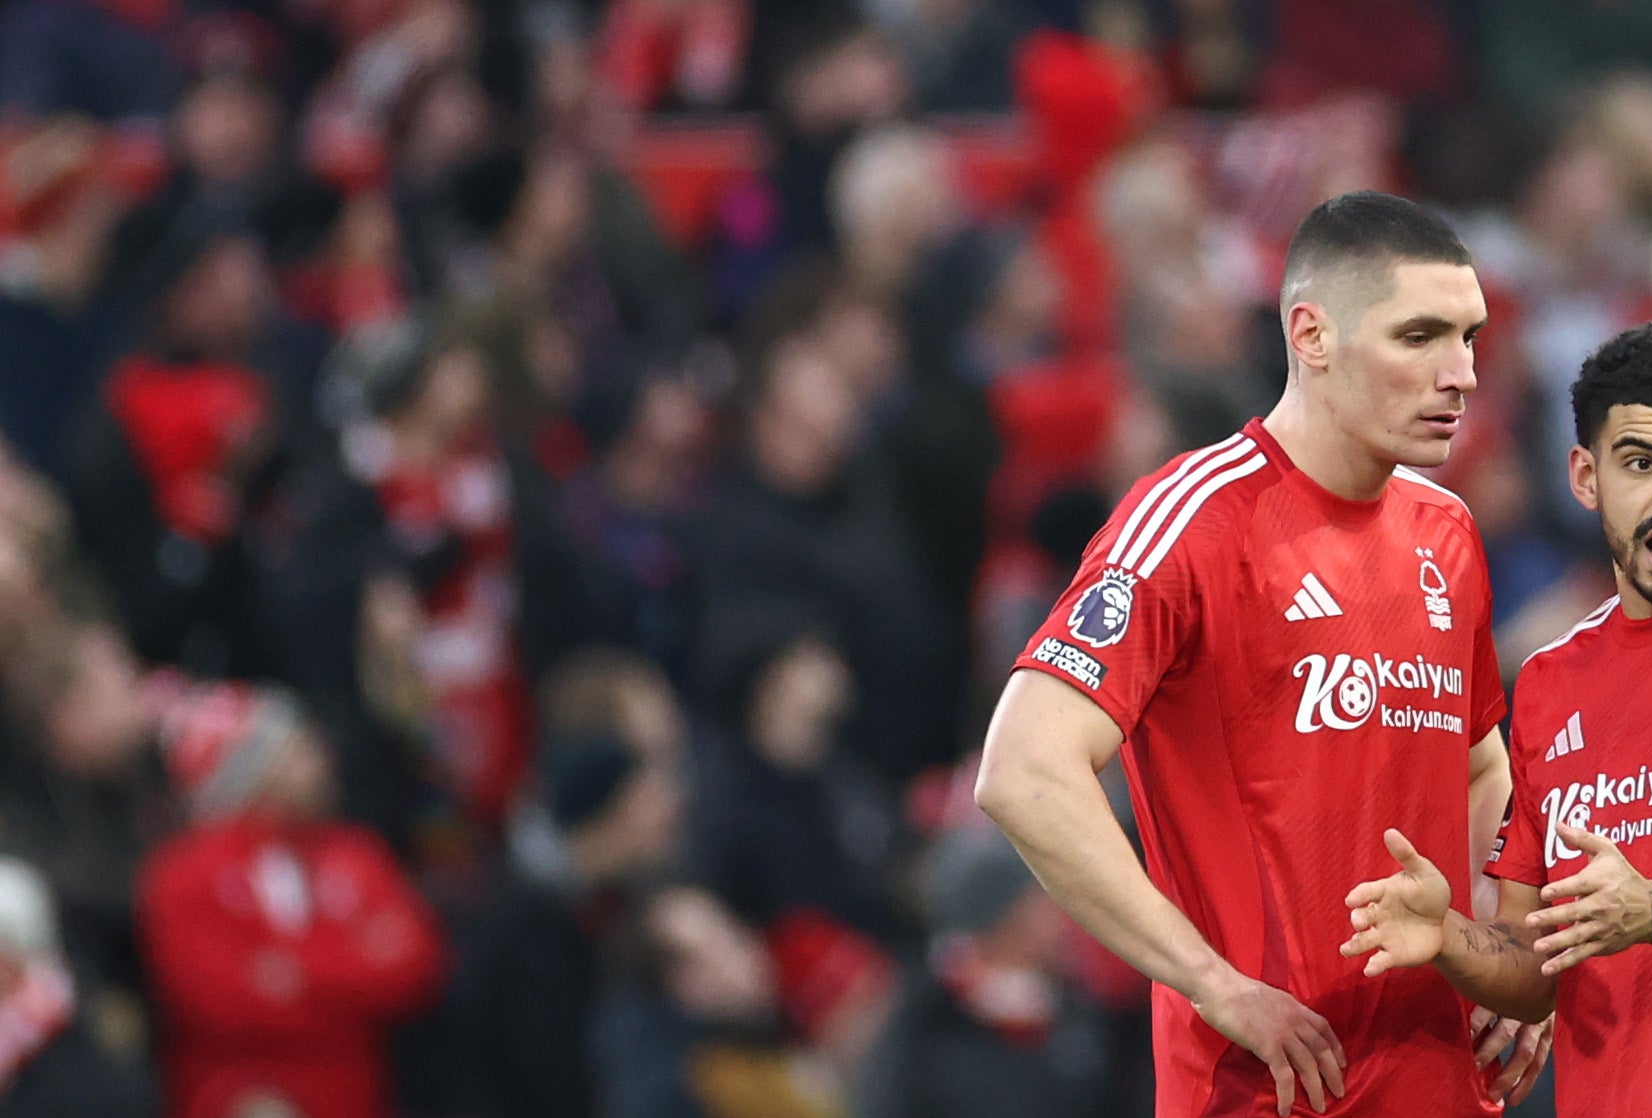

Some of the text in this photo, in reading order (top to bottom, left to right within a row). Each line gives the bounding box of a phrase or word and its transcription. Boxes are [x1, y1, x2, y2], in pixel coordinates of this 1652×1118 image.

[1039, 637, 1101, 676] No room
[1373, 653, 1462, 698] kaiyun
[1381, 704, 1463, 734] kaiyun.com
